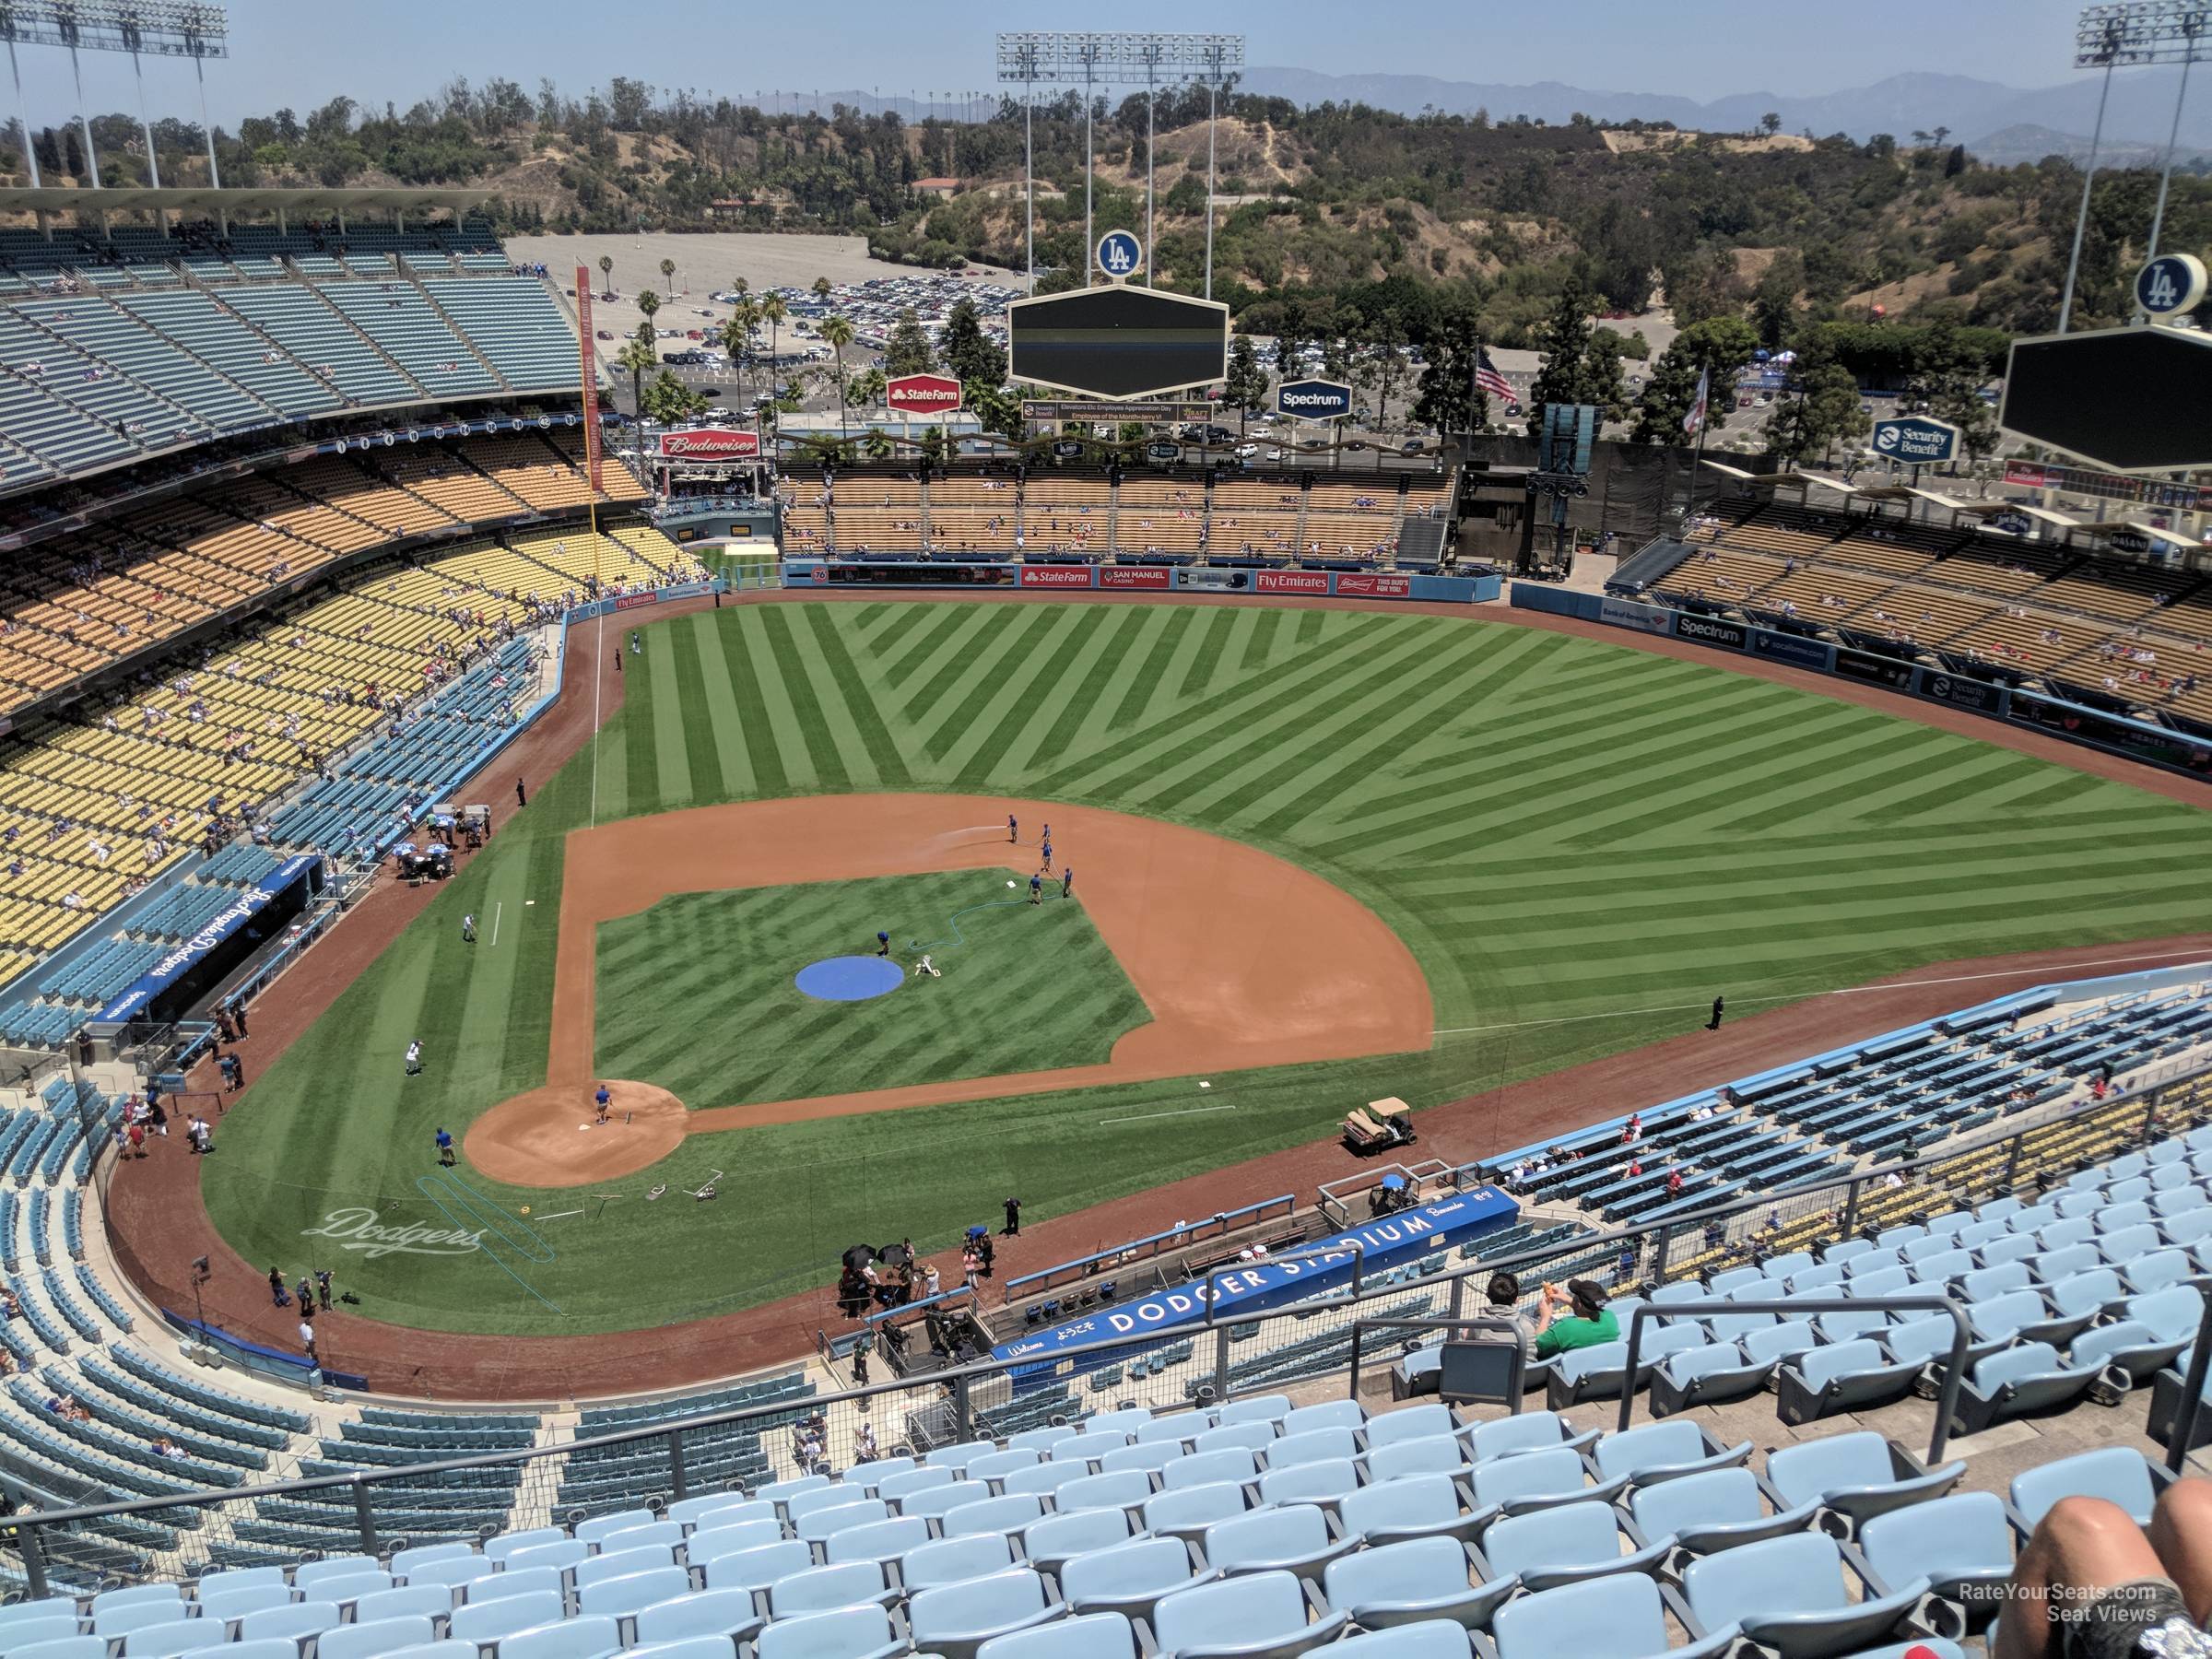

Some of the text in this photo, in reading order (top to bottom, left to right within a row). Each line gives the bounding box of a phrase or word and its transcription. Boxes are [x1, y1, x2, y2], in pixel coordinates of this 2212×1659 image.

[1109, 239, 1129, 269] LA
[2147, 265, 2177, 306] LA
[584, 356, 597, 406] Fly Emirates
[1283, 393, 1341, 406] Spectrum
[1072, 413, 1100, 421] Employee
[1097, 405, 1124, 413] Employee
[1124, 405, 1159, 414] Appreciation
[665, 437, 756, 453] Budweiser
[1902, 428, 1948, 446] Security
[589, 424, 600, 473] Fly Emirates
[1901, 441, 1939, 456] Benefit
[1259, 575, 1327, 588] Fly Emirates
[618, 594, 655, 608] Fly Emirates
[1680, 618, 1739, 642] Spectrum
[201, 900, 252, 937] Angeles
[150, 935, 218, 977] Dodgers
[300, 1207, 488, 1259] Dodgers
[1109, 1270, 1267, 1333] DODGER
[1057, 1321, 1096, 1340] ようこそ
[1008, 1341, 1044, 1357] Welcome
